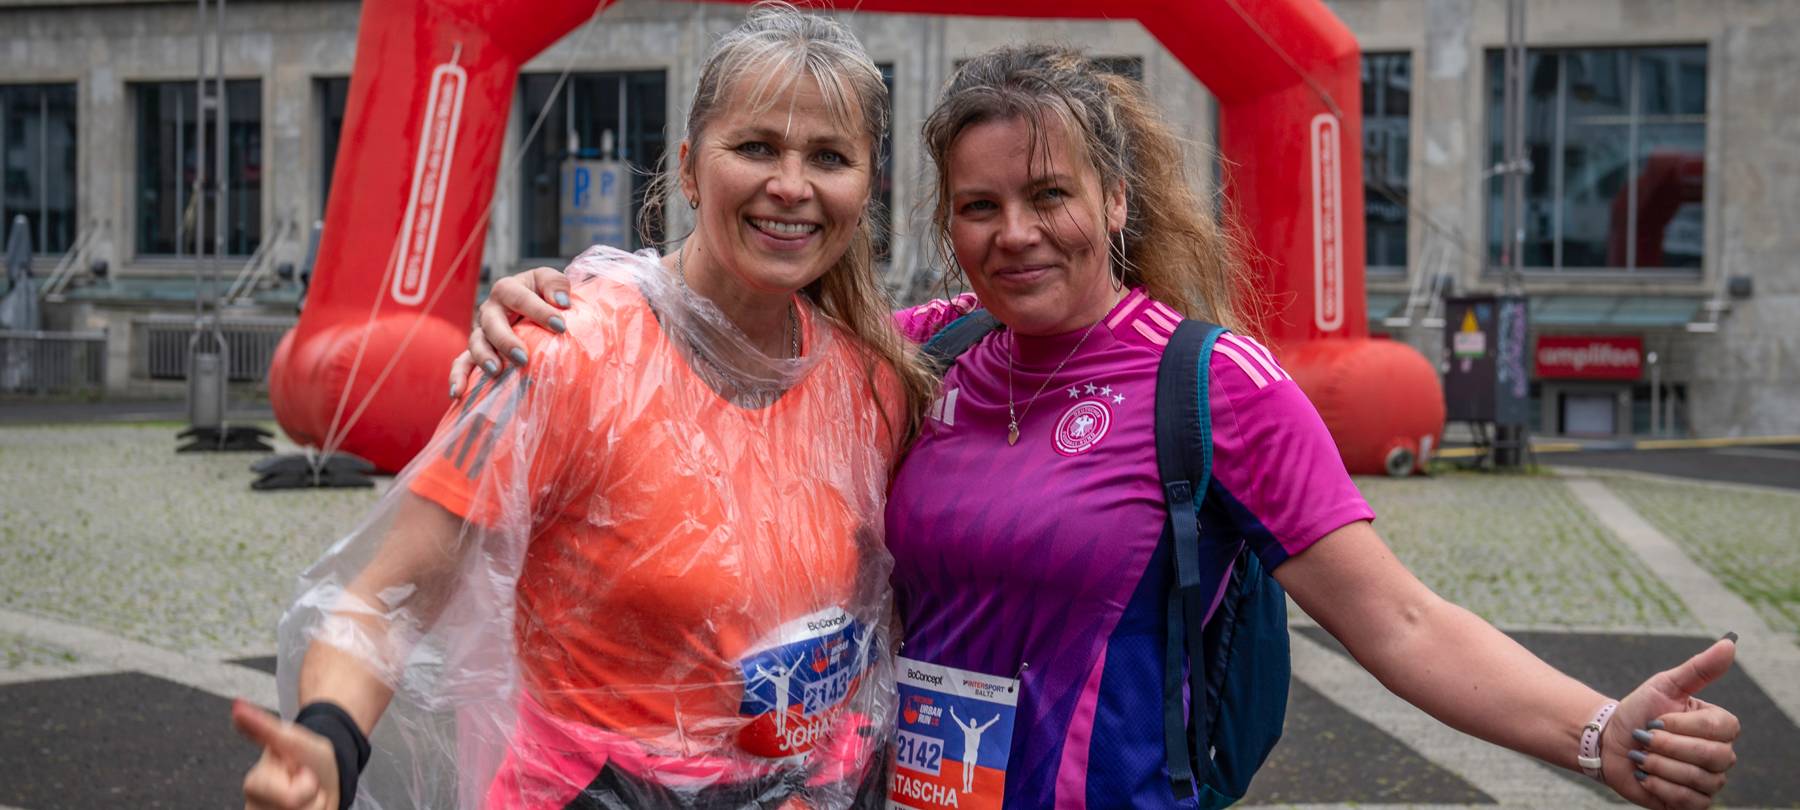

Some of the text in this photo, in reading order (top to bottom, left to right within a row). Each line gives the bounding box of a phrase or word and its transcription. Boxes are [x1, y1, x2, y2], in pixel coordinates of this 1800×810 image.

[1539, 343, 1639, 371] amplifon
[907, 668, 944, 686] BoConcept
[967, 680, 1005, 693] INTERSPORT
[805, 671, 848, 714] 2143
[920, 704, 943, 717] URBAN
[897, 735, 941, 771] 2142
